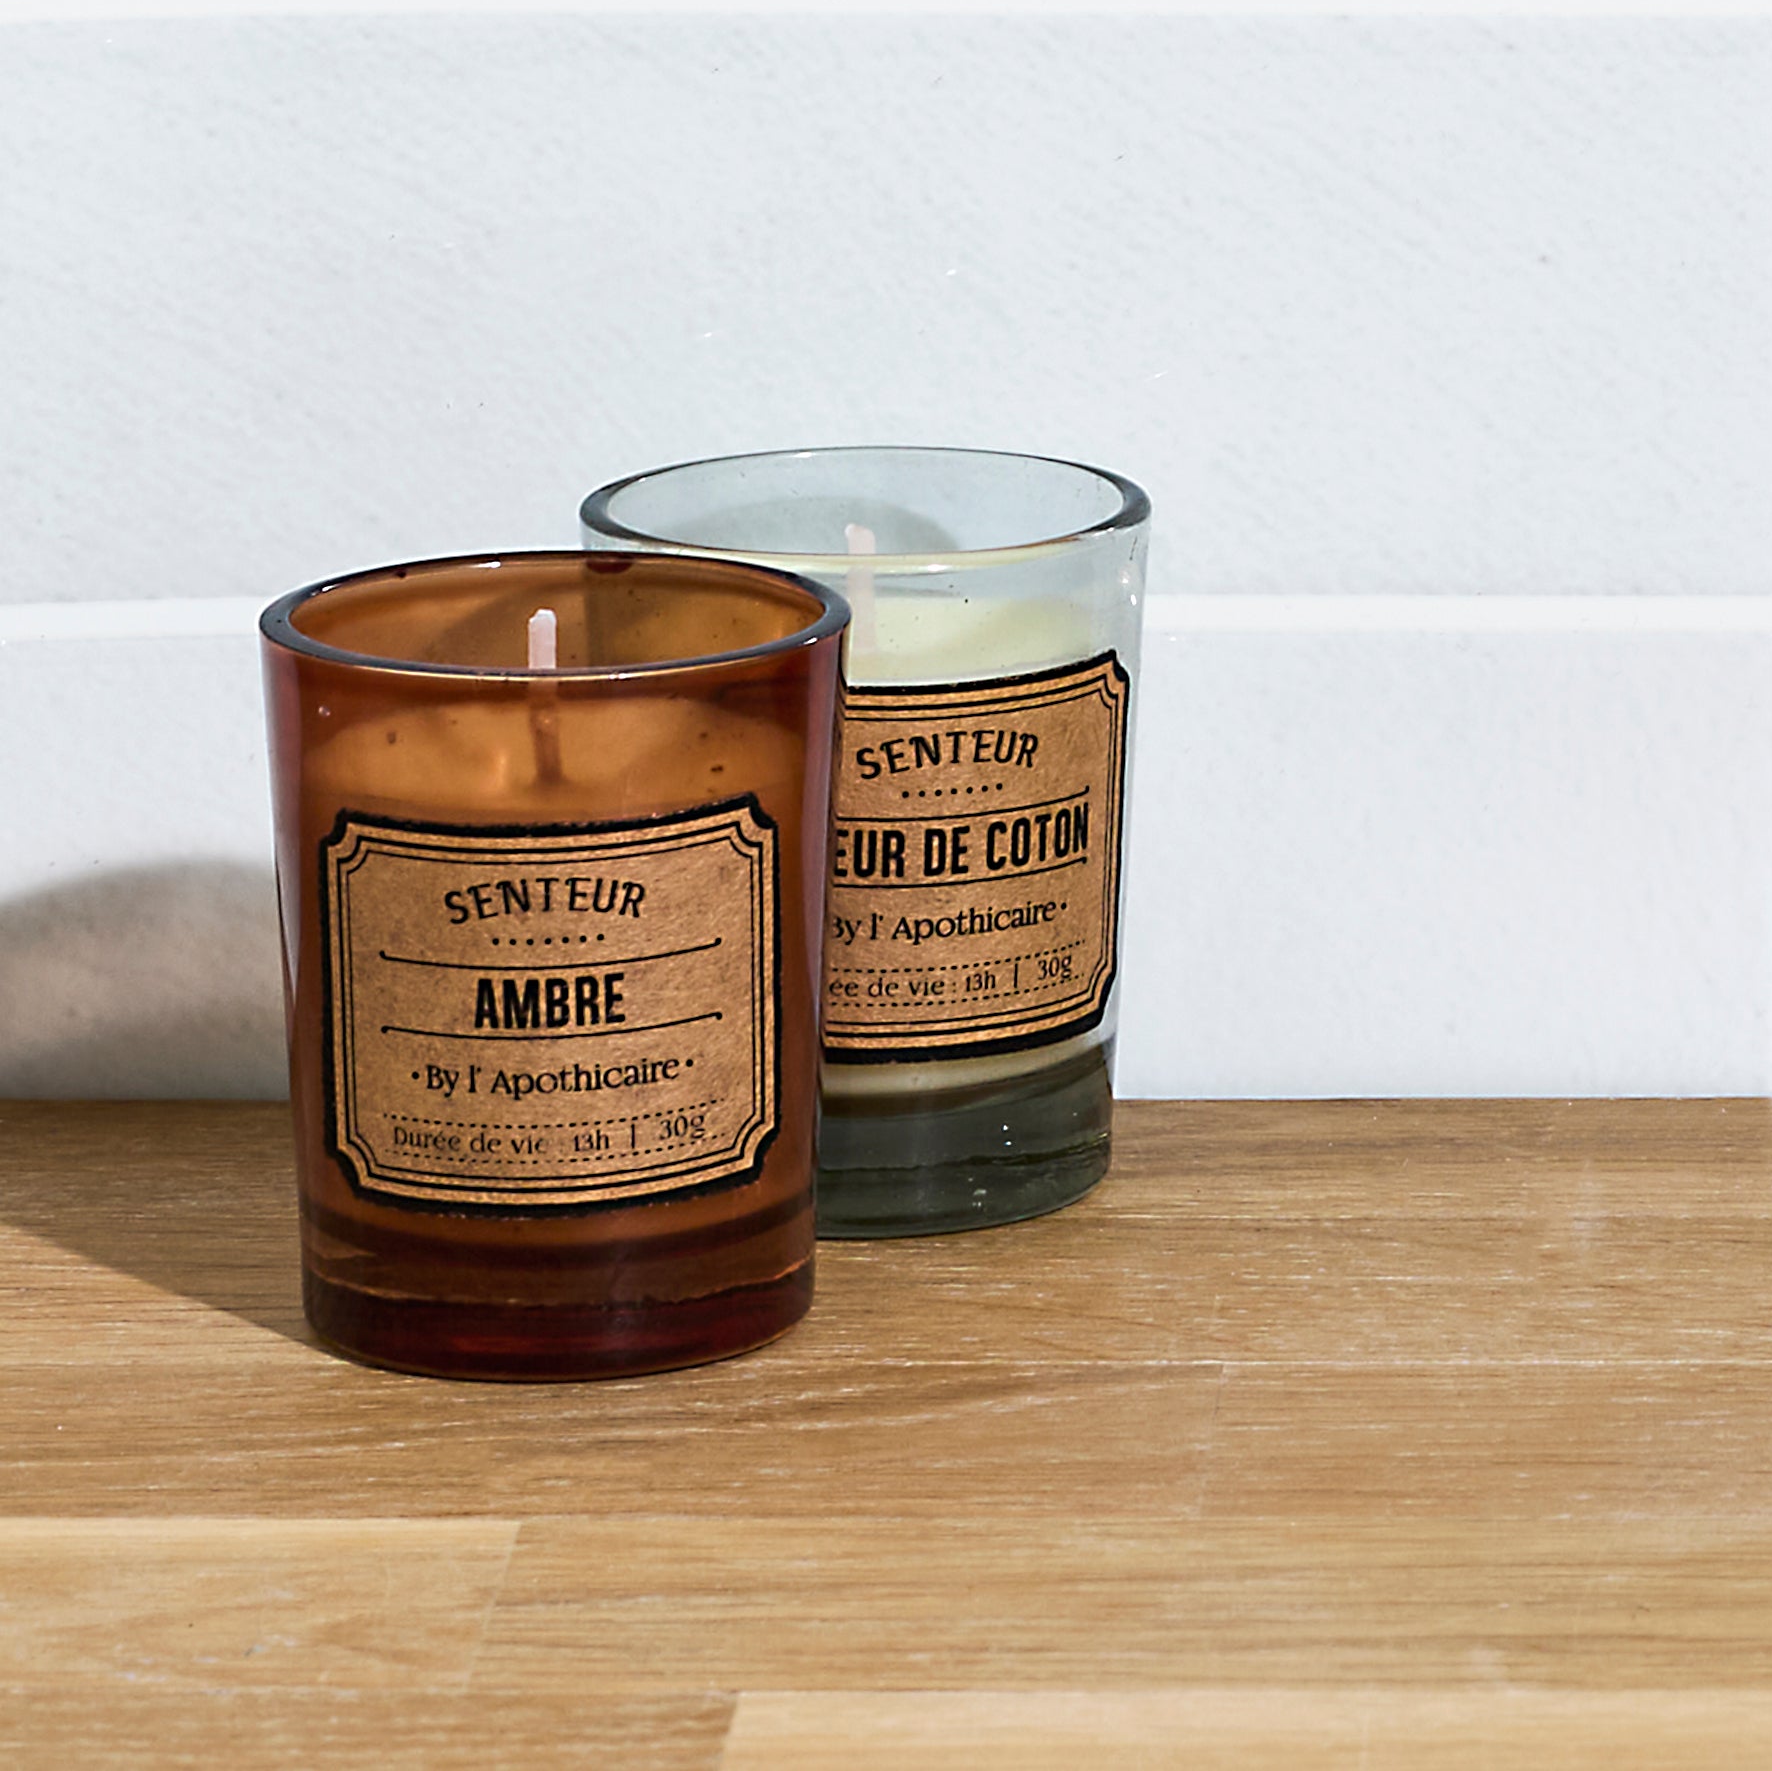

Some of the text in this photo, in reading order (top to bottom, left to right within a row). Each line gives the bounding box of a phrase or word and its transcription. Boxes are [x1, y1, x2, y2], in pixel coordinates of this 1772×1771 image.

[855, 729, 1039, 780] SENTEUR
[833, 801, 1089, 878] EUR DE COTON
[444, 877, 646, 924] SENTEUR
[891, 901, 1057, 945] Apothicaire
[867, 977, 899, 998] de
[908, 980, 945, 997] vie
[965, 971, 996, 993] 13h
[1037, 954, 1073, 981] 30g
[474, 972, 626, 1029] AMBRE
[425, 1064, 460, 1099] By
[489, 1057, 680, 1101] Apothicaire
[393, 1126, 461, 1151] Durée
[469, 1132, 502, 1154] de
[573, 1129, 610, 1152] 13h
[659, 1115, 706, 1141] 30g
